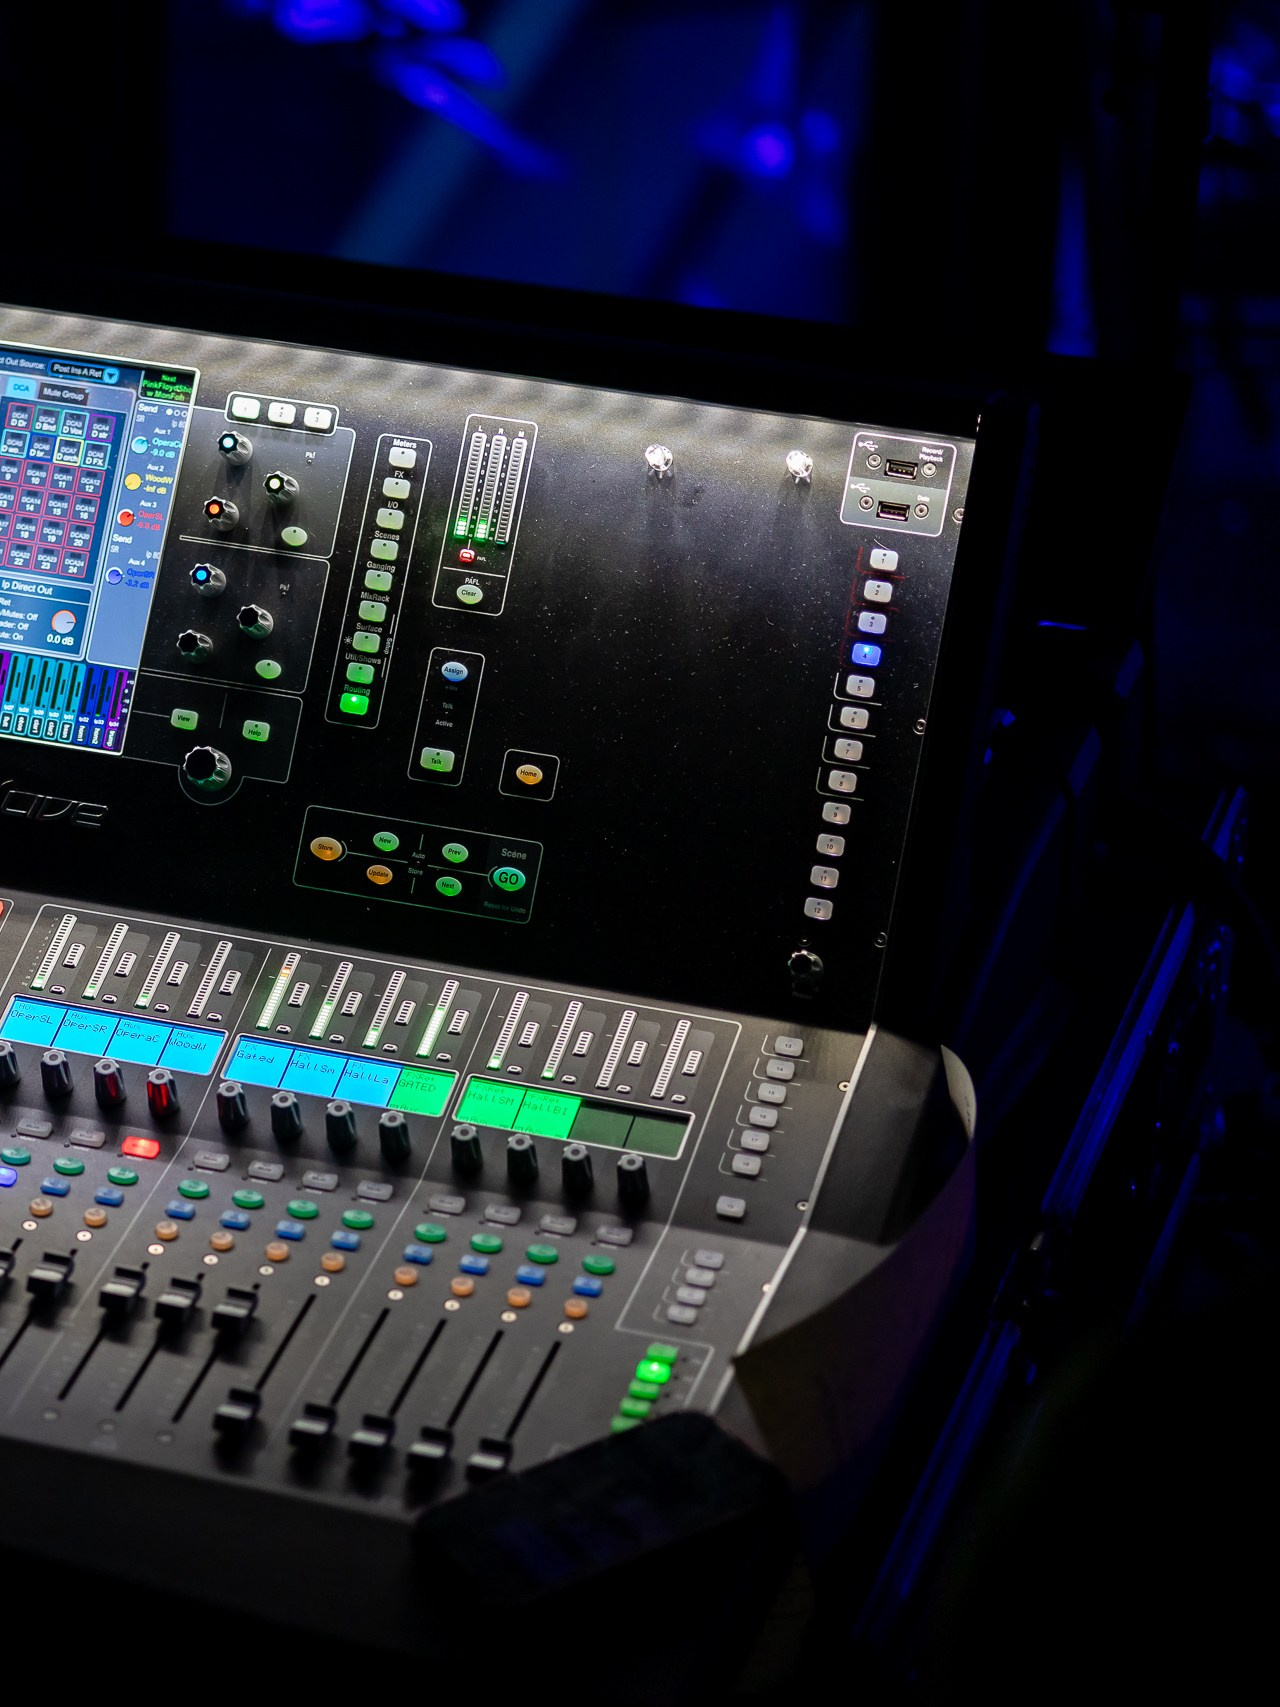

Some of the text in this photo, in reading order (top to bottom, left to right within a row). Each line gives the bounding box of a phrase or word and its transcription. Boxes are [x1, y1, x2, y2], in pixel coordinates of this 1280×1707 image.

[13, 383, 30, 392] DCA
[43, 387, 84, 401] Mute Group
[138, 403, 158, 413] Send
[393, 439, 417, 449] Meters
[165, 450, 176, 458] dB
[919, 454, 944, 463] Playback
[53, 473, 73, 482] DCA11
[394, 470, 404, 478] FX
[80, 477, 101, 486] DCA12
[21, 495, 41, 505] DCA14
[387, 501, 398, 509] I/O
[112, 533, 132, 544] Send
[375, 530, 400, 540] Scenes
[10, 550, 31, 559] DCA22
[37, 554, 58, 563] DCA23
[64, 558, 85, 567] DCA24
[367, 561, 396, 572] Ganging
[11, 581, 36, 593] Direct
[37, 584, 53, 595] Out
[361, 591, 390, 603] MixRack
[461, 589, 477, 598] Clear
[0, 597, 12, 606] Ret
[26, 613, 39, 622] Off
[17, 622, 30, 631] Off
[356, 622, 383, 633] Surface
[12, 632, 24, 641] On
[46, 633, 75, 647] 0.0 dB
[384, 637, 393, 655] Setup
[345, 653, 382, 665] Util/Shows
[444, 666, 463, 676] Assign
[344, 684, 371, 695] Routing
[177, 715, 191, 723] View
[435, 719, 453, 728] Active
[248, 729, 262, 737] Help
[520, 769, 537, 778] Home
[378, 836, 392, 845] New
[317, 843, 333, 851] Store
[448, 847, 462, 857] Prev
[411, 851, 426, 860] Auto
[501, 848, 527, 860] Scene
[368, 869, 389, 879] Update
[408, 867, 424, 876] Store
[498, 871, 519, 885] GO
[441, 881, 455, 889] Next
[10, 1009, 53, 1026] OperSL
[63, 1018, 108, 1034] OperSR
[237, 1050, 274, 1064] Gated
[290, 1059, 335, 1075] HallSm
[344, 1069, 389, 1085] HallLa
[398, 1078, 436, 1092] GATED
[468, 1091, 514, 1106] HallSM
[522, 1100, 569, 1116] HallBI
